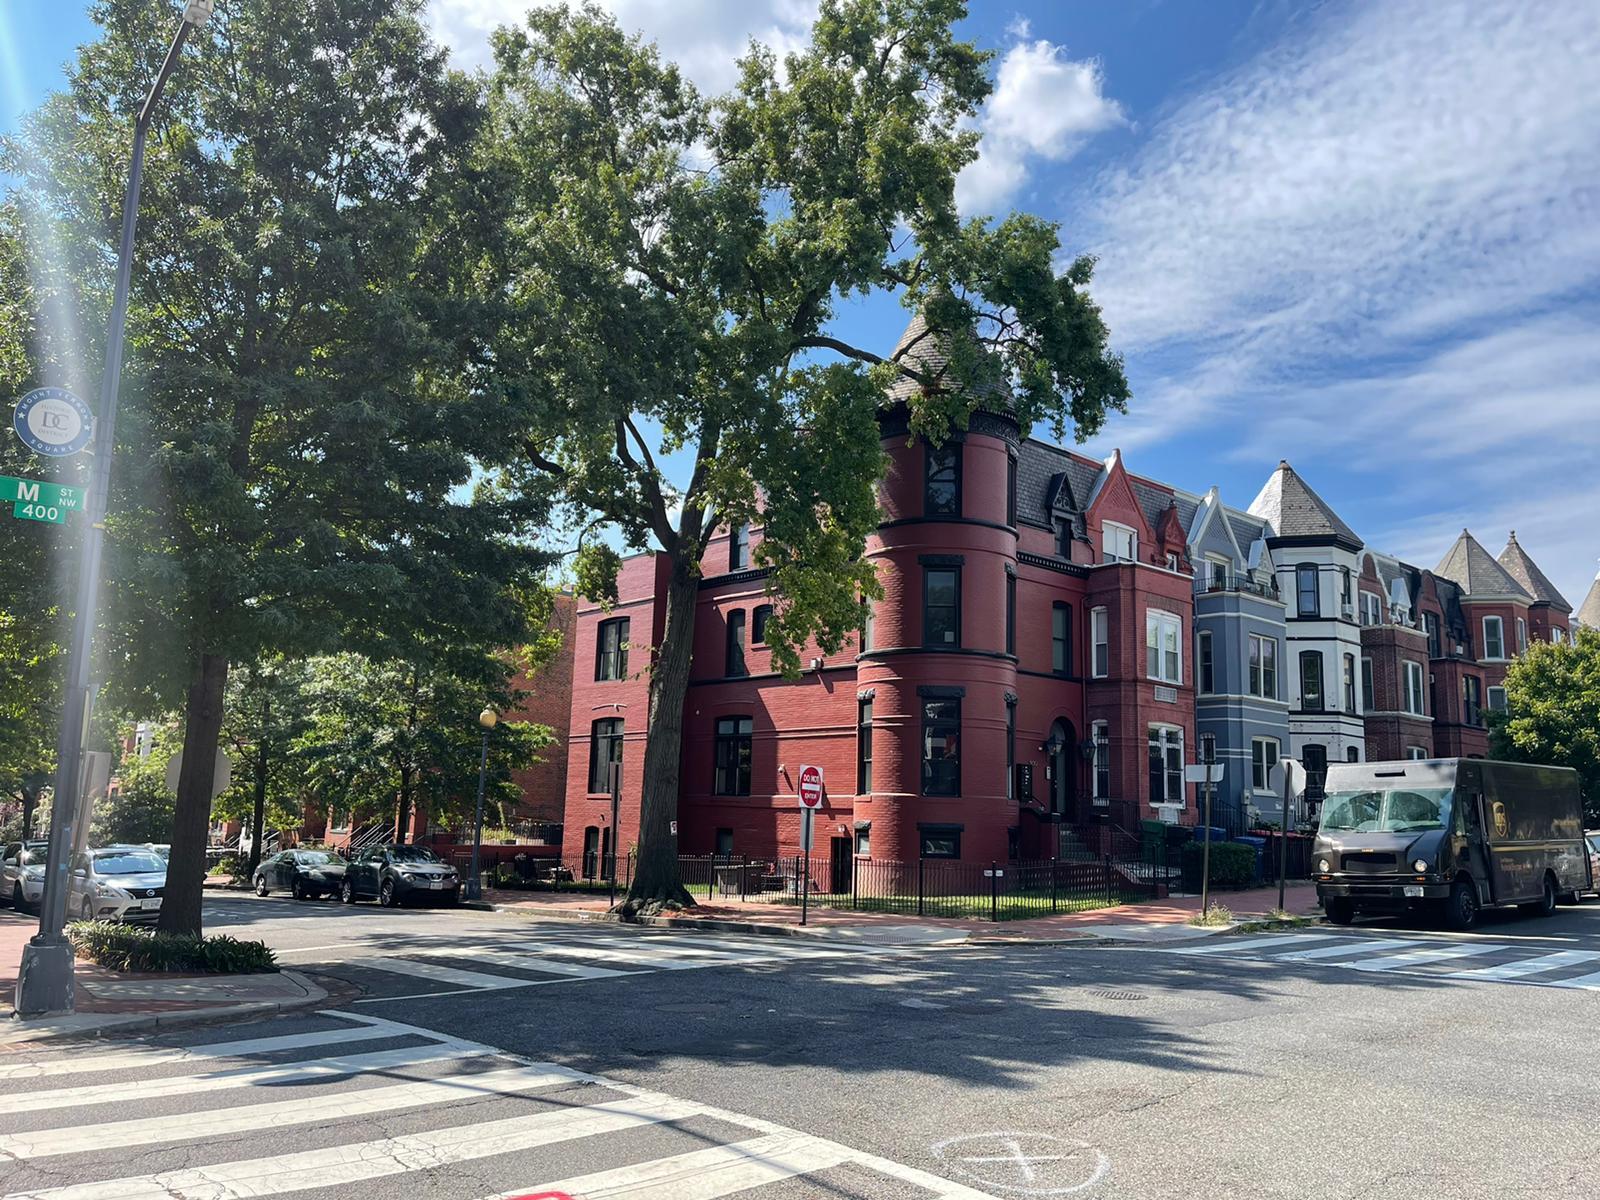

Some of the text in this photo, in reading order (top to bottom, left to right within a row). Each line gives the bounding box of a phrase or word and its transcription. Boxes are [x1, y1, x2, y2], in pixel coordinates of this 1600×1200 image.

[22, 390, 51, 409] MOUNT
[43, 411, 70, 431] DC
[30, 439, 73, 453] SQUARE
[17, 481, 74, 502] M ST
[58, 498, 77, 507] NW
[22, 504, 59, 520] 400
[803, 774, 819, 783] DO NOT
